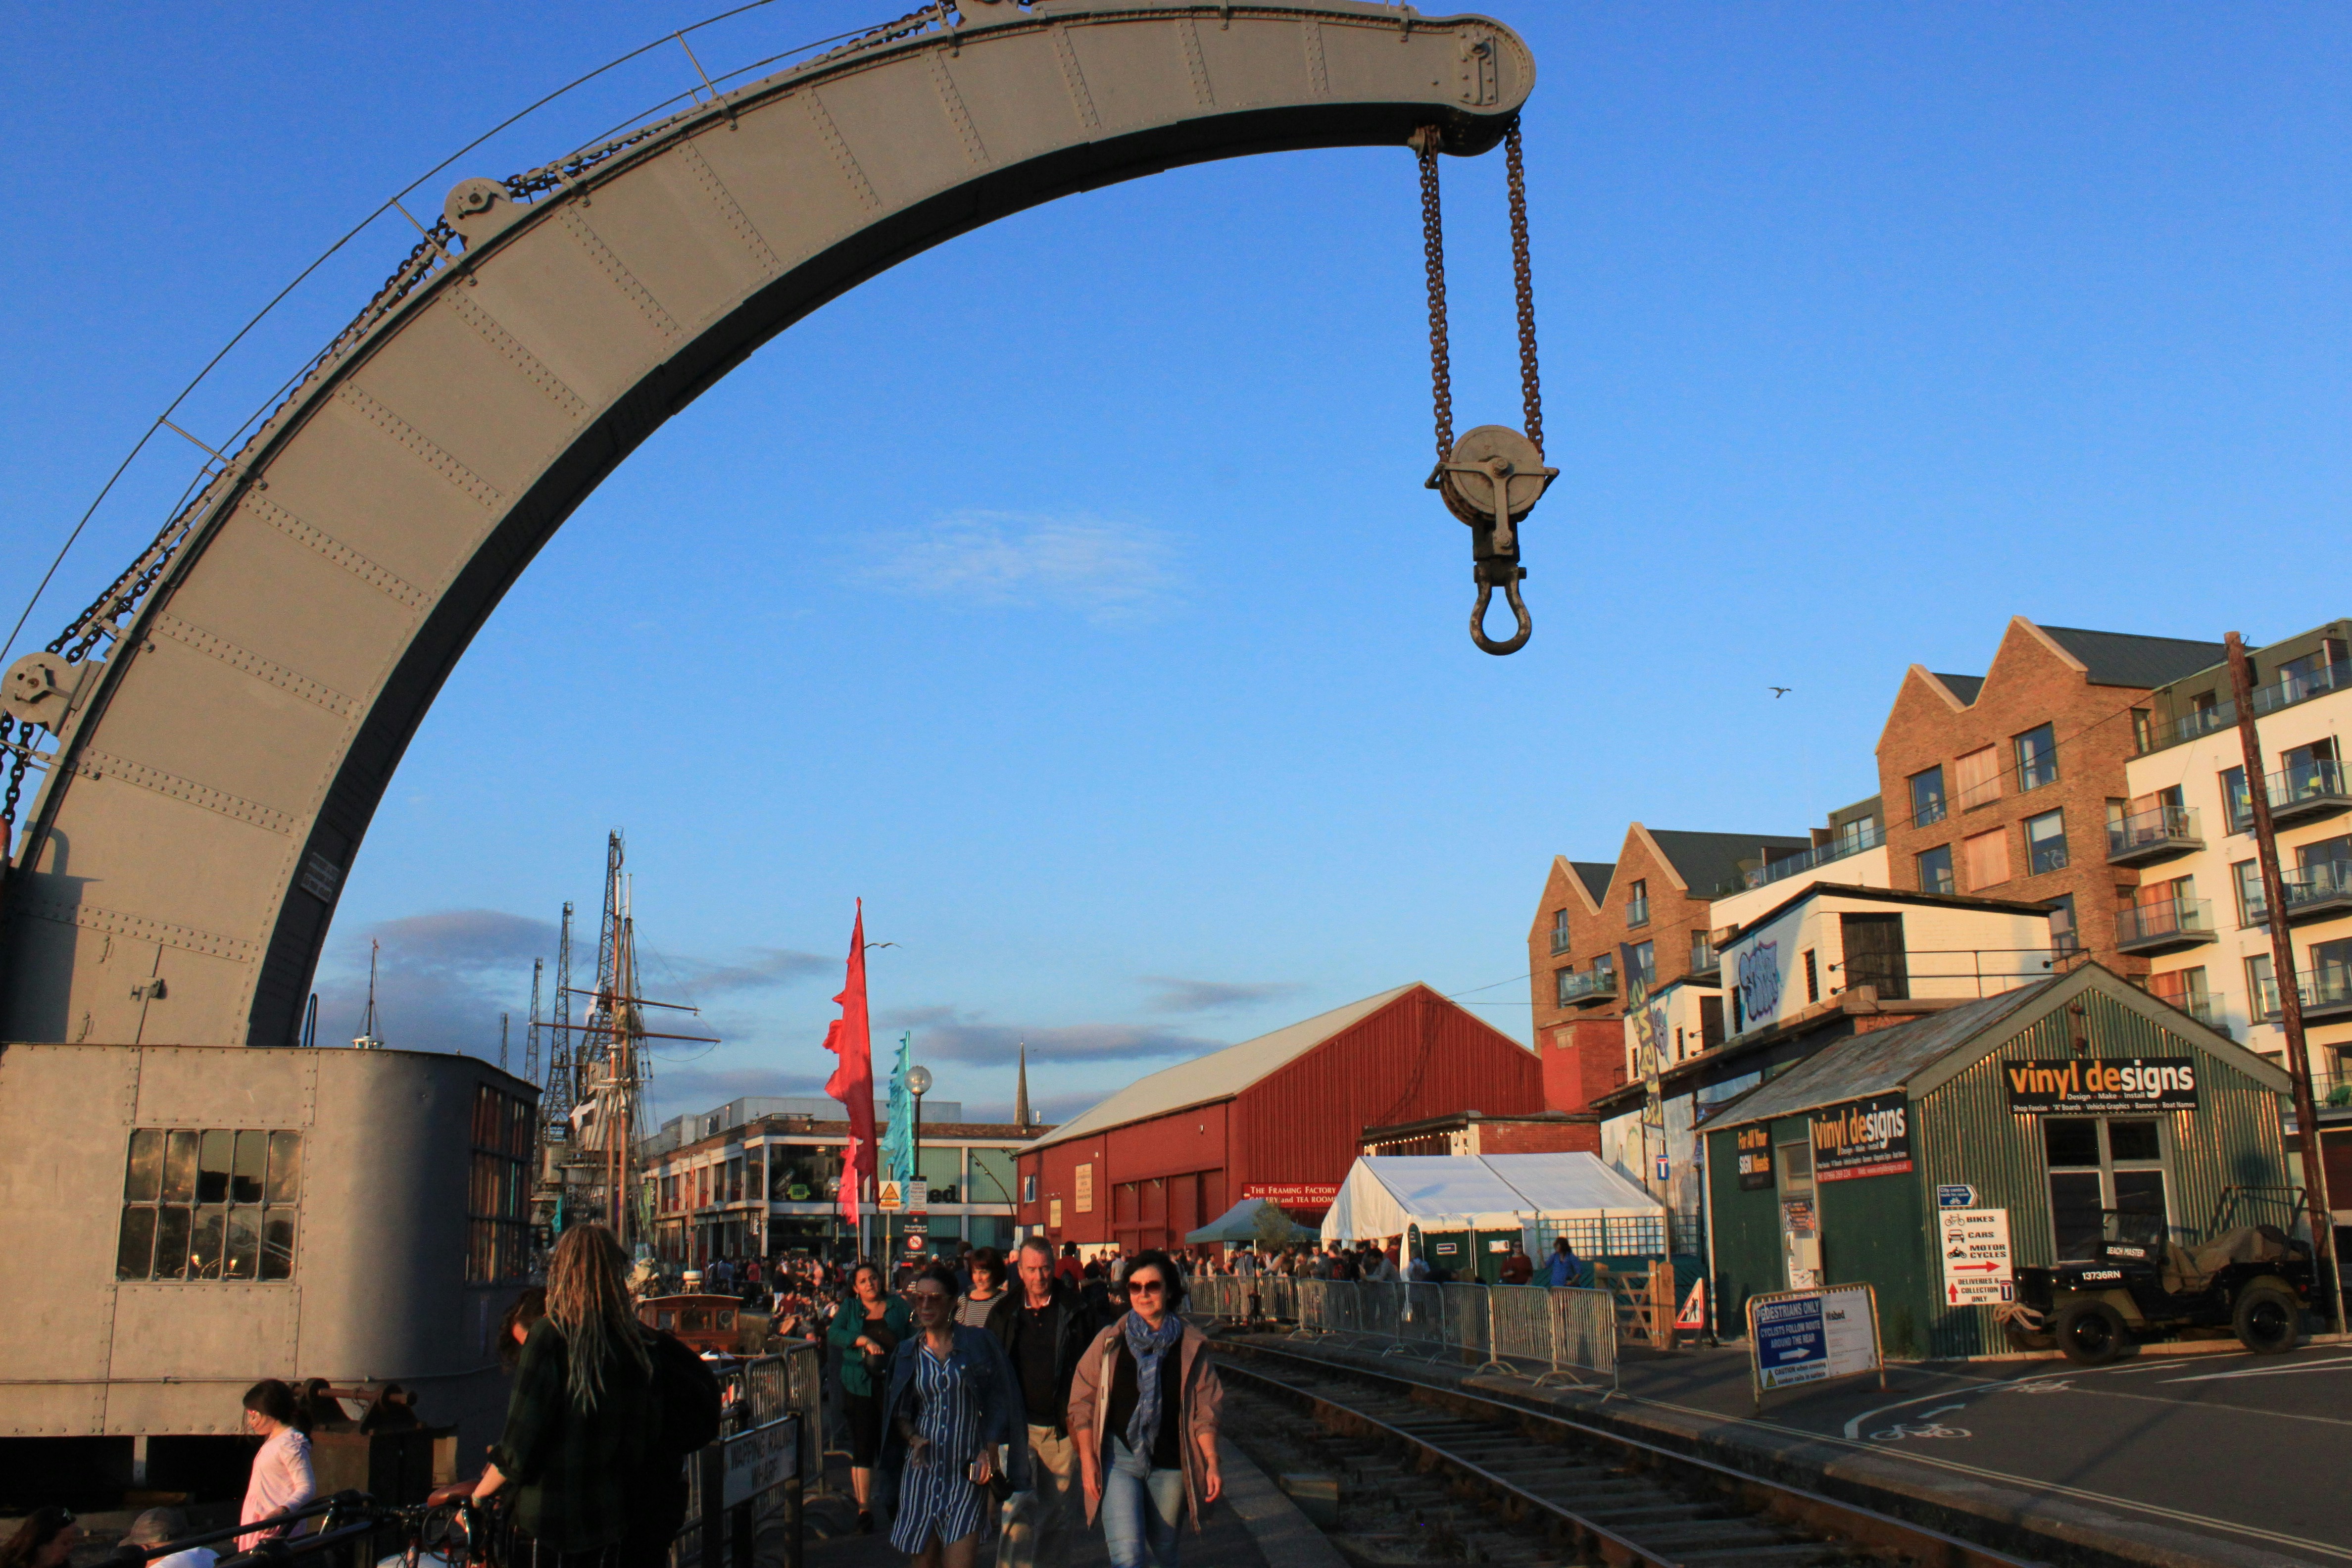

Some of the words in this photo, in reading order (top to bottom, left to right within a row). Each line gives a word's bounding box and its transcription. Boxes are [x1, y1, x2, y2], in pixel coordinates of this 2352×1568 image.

[2009, 1061, 2080, 1101] vinyl
[2086, 1059, 2195, 1099] designs
[2106, 1103, 2130, 1112] Graphics
[1738, 1132, 1747, 1149] For
[1754, 1128, 1767, 1147] Your
[1814, 1110, 1847, 1156] vinyl
[1850, 1103, 1905, 1149] designs
[1739, 1155, 1752, 1175] SIGN
[1752, 1153, 1769, 1172] Needs
[2107, 1246, 2123, 1256] BEACH
[2124, 1248, 2146, 1257] MASTER
[2082, 1271, 2122, 1281] 13736RN
[1757, 1303, 1802, 1321] PEDESTRIANS
[1803, 1300, 1819, 1314] ONLY
[1760, 1324, 1785, 1337] CYCLISTS
[1785, 1322, 1805, 1334] FOLLOW
[1805, 1320, 1820, 1330] ROUTE
[1771, 1337, 1791, 1348] AROUND
[1792, 1335, 1802, 1345] THE
[1802, 1333, 1815, 1343] REAR
[1775, 1366, 1795, 1375] CAUTION
[731, 1434, 765, 1470] WAPPING
[752, 1457, 778, 1490] WHARF
